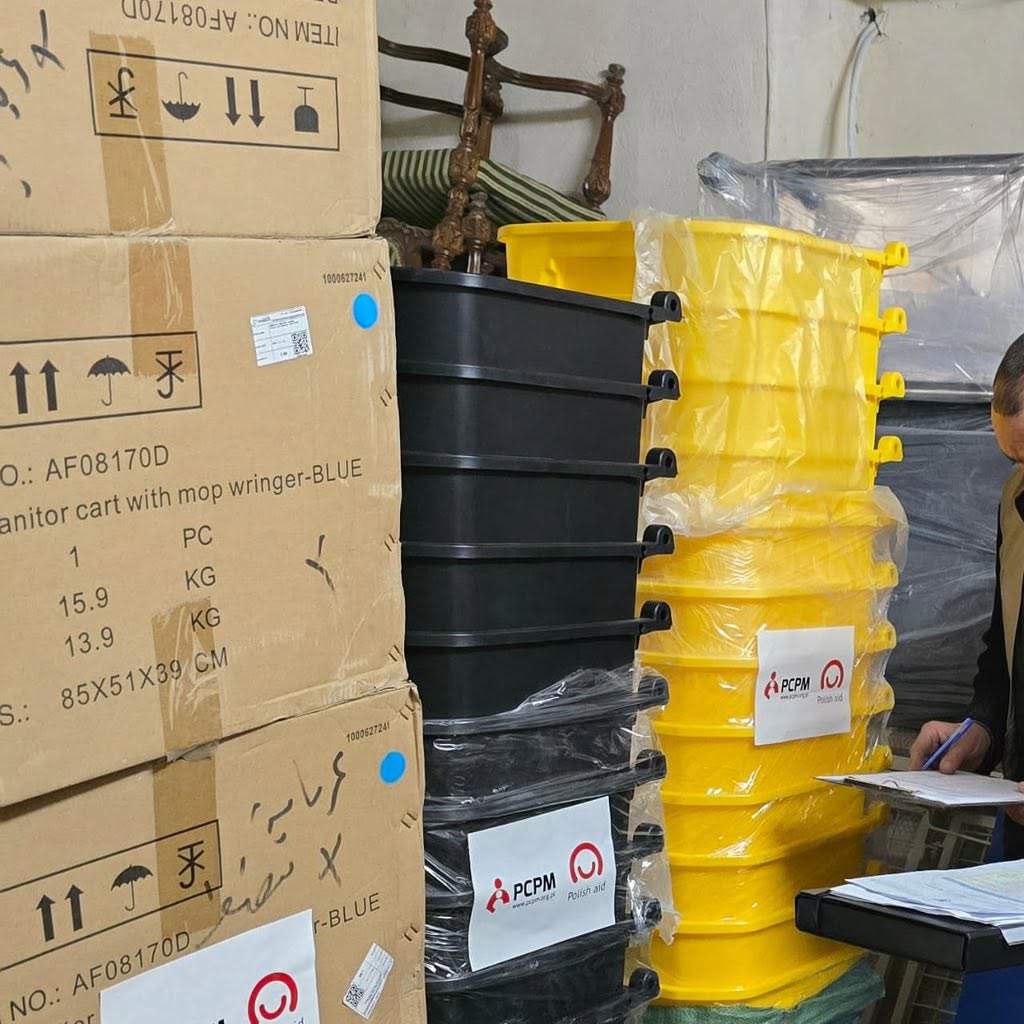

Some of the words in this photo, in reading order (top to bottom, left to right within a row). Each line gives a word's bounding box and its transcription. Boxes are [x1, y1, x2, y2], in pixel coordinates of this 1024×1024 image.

[121, 0, 237, 32] AF08170D
[248, 13, 289, 40] NO.:
[294, 20, 339, 47] ITEM
[322, 272, 367, 284] 1000627241
[0, 464, 33, 487] O.:
[46, 444, 169, 482] AF08170D
[0, 506, 69, 535] anitor
[76, 494, 121, 520] cart
[127, 487, 172, 512] with
[178, 480, 223, 504] mop
[229, 458, 363, 497] wringer-BLUE
[69, 545, 79, 567] 1
[183, 525, 213, 548] PC
[59, 586, 109, 617] 15.9
[185, 566, 217, 590] KG
[64, 626, 115, 657] 13.9
[190, 607, 222, 632] KG
[61, 659, 183, 710] 85X51X39
[194, 647, 229, 674] CM
[781, 676, 810, 693] PCPM
[513, 872, 556, 901] PCPM
[567, 887, 591, 901] Polish
[593, 881, 606, 892] aid
[313, 892, 381, 934] r-BLUE
[10, 987, 61, 1021] NO.:
[72, 930, 191, 996] AF08170D
